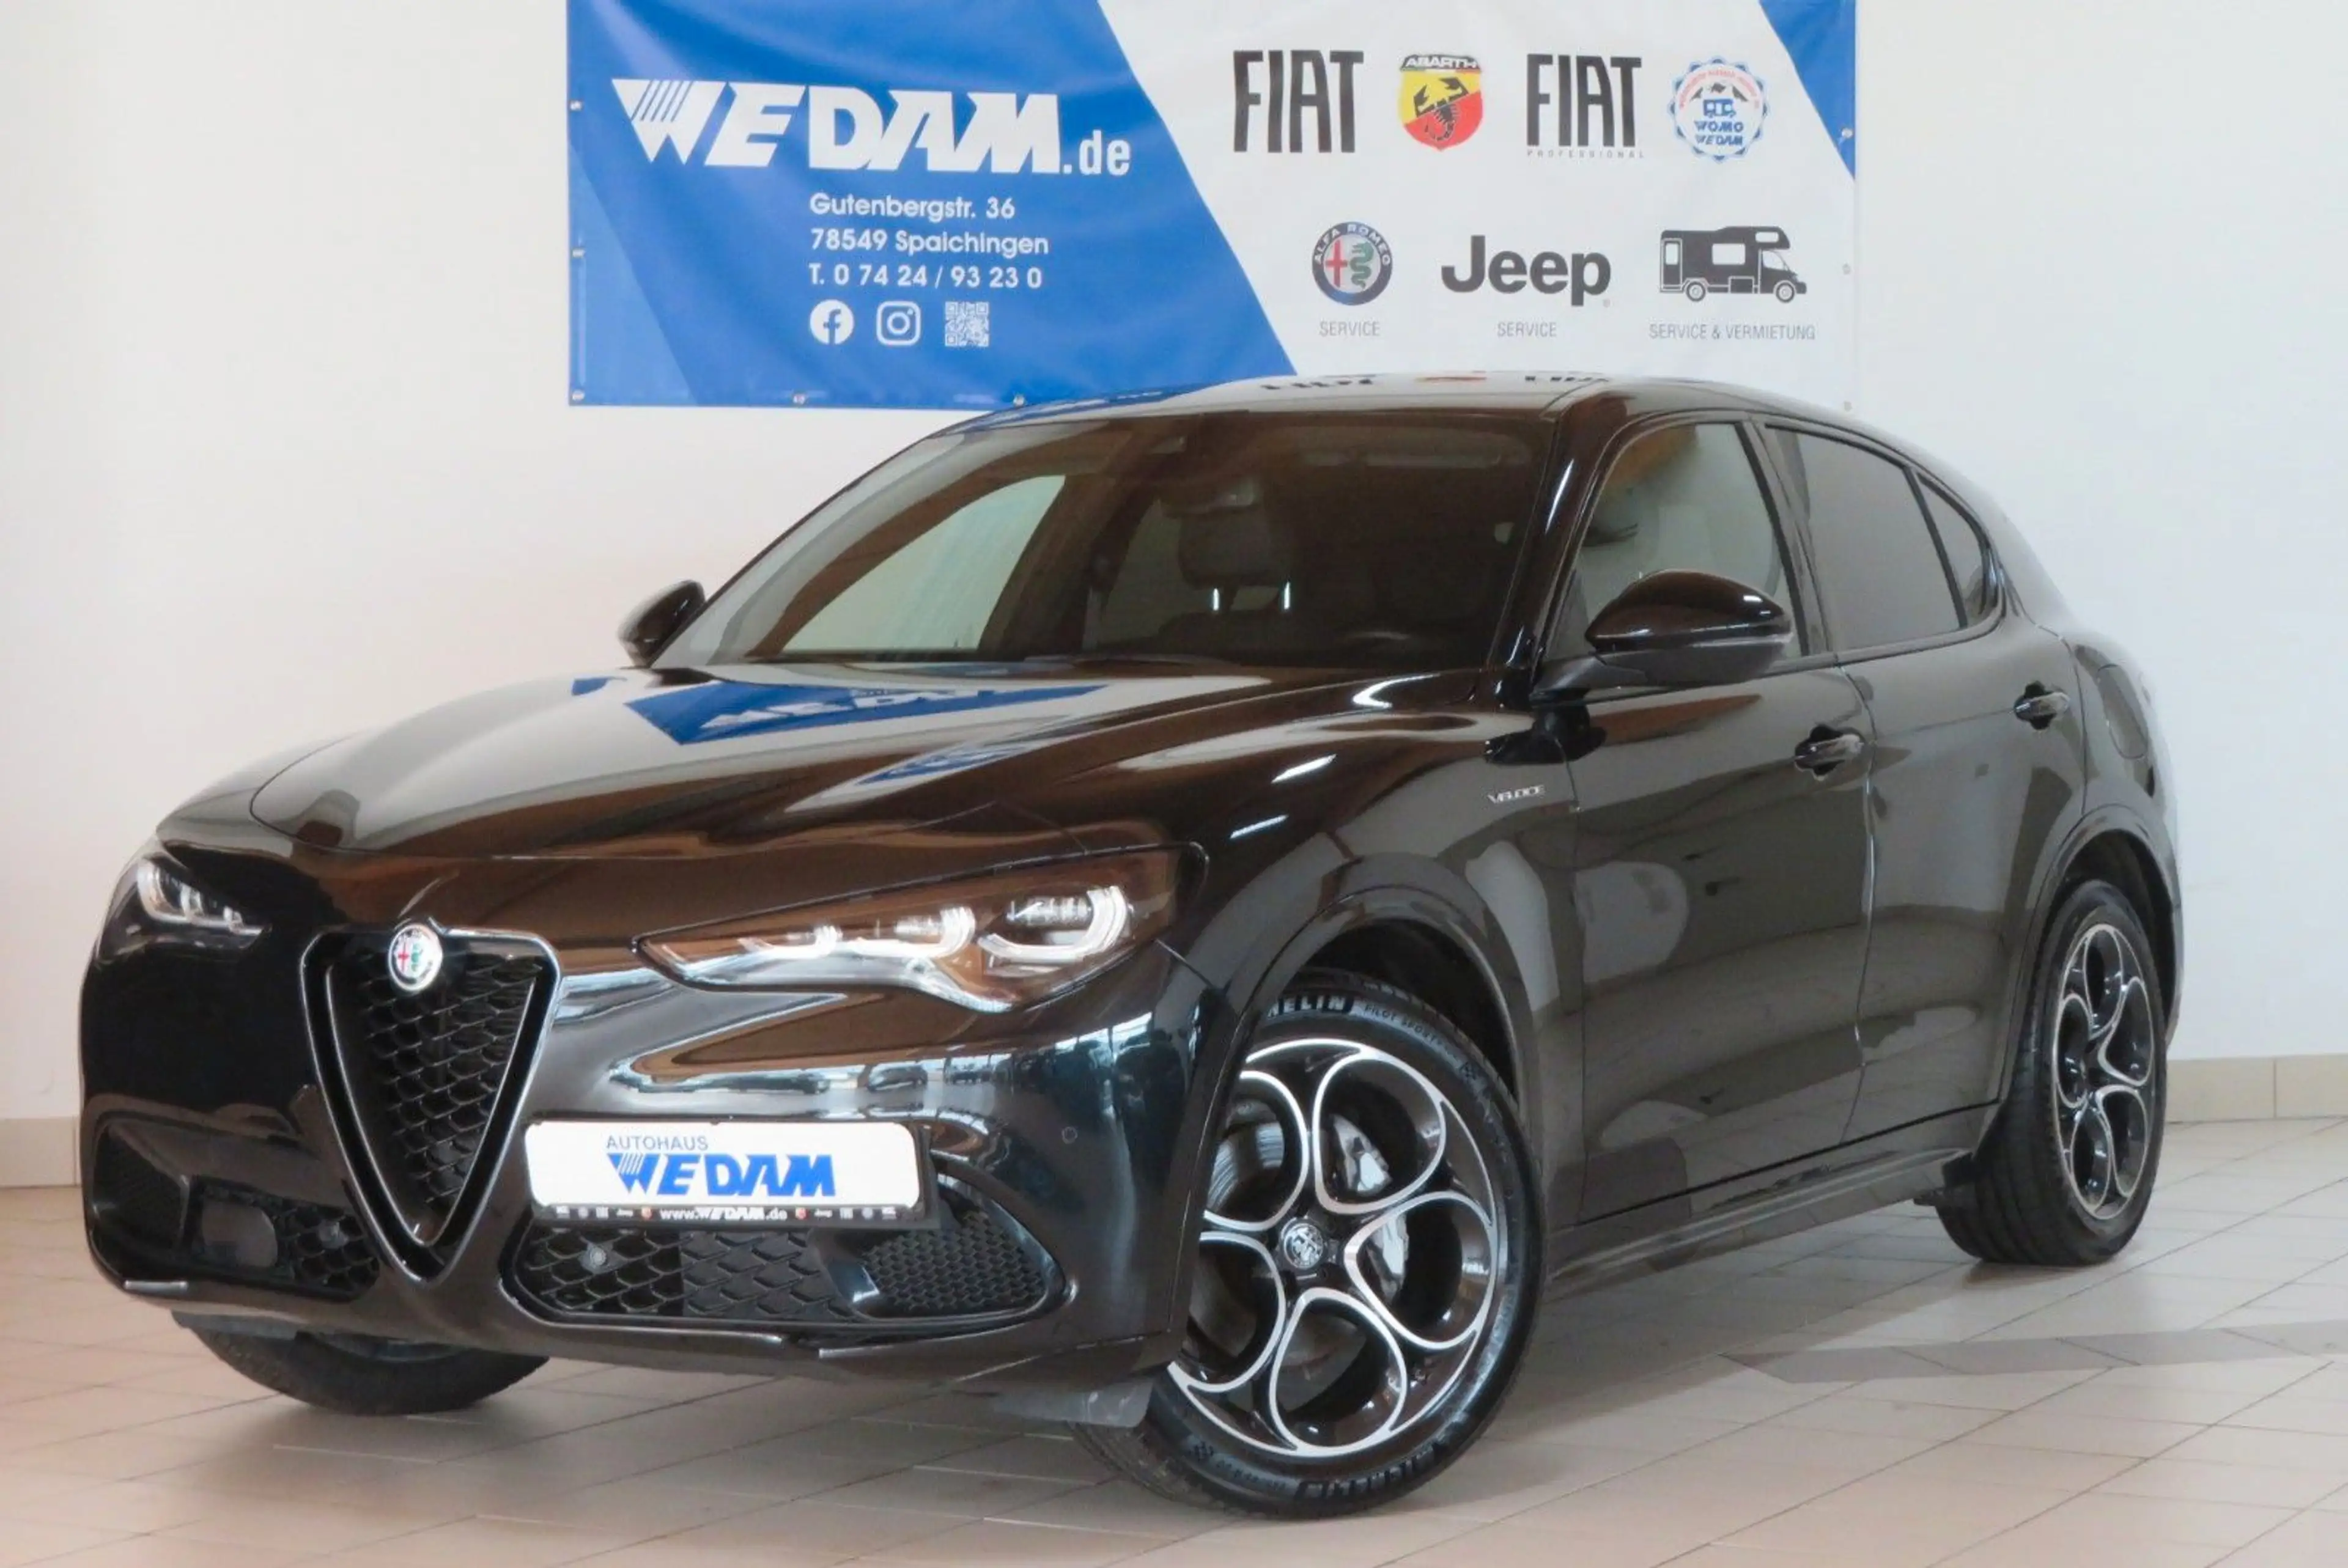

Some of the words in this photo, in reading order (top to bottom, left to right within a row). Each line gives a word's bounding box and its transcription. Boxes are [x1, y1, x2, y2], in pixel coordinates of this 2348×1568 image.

[1405, 54, 1477, 68] ABARTH
[1233, 50, 1364, 153] FIAT
[1527, 54, 1642, 147] FIAT
[612, 78, 1131, 176] WEDAM.de
[810, 193, 976, 223] Gutenbergstr.
[986, 196, 1015, 219] 36
[811, 228, 887, 251] 78549
[895, 230, 1049, 259] Spaichingen
[1314, 227, 1341, 265] ALFA
[1347, 224, 1390, 265] ROMEO
[809, 263, 824, 285] T.
[834, 263, 849, 286] 0
[859, 264, 888, 286] 74
[898, 265, 928, 287] 24
[935, 265, 943, 289] /
[950, 267, 980, 288] 93
[989, 267, 1019, 288] 23
[1027, 268, 1043, 289] 0
[1441, 235, 1611, 307] Jeep
[1319, 321, 1381, 337] SERVICE
[1497, 321, 1557, 337] SERVICE
[1649, 323, 1707, 339] SERVICE
[1713, 325, 1720, 339] &
[1726, 323, 1815, 340] VERMIETUNG
[607, 1135, 709, 1150] AUTOHAUS
[607, 1154, 836, 1197] WEDAM
[659, 1206, 788, 1221] www.WEDAM.de
